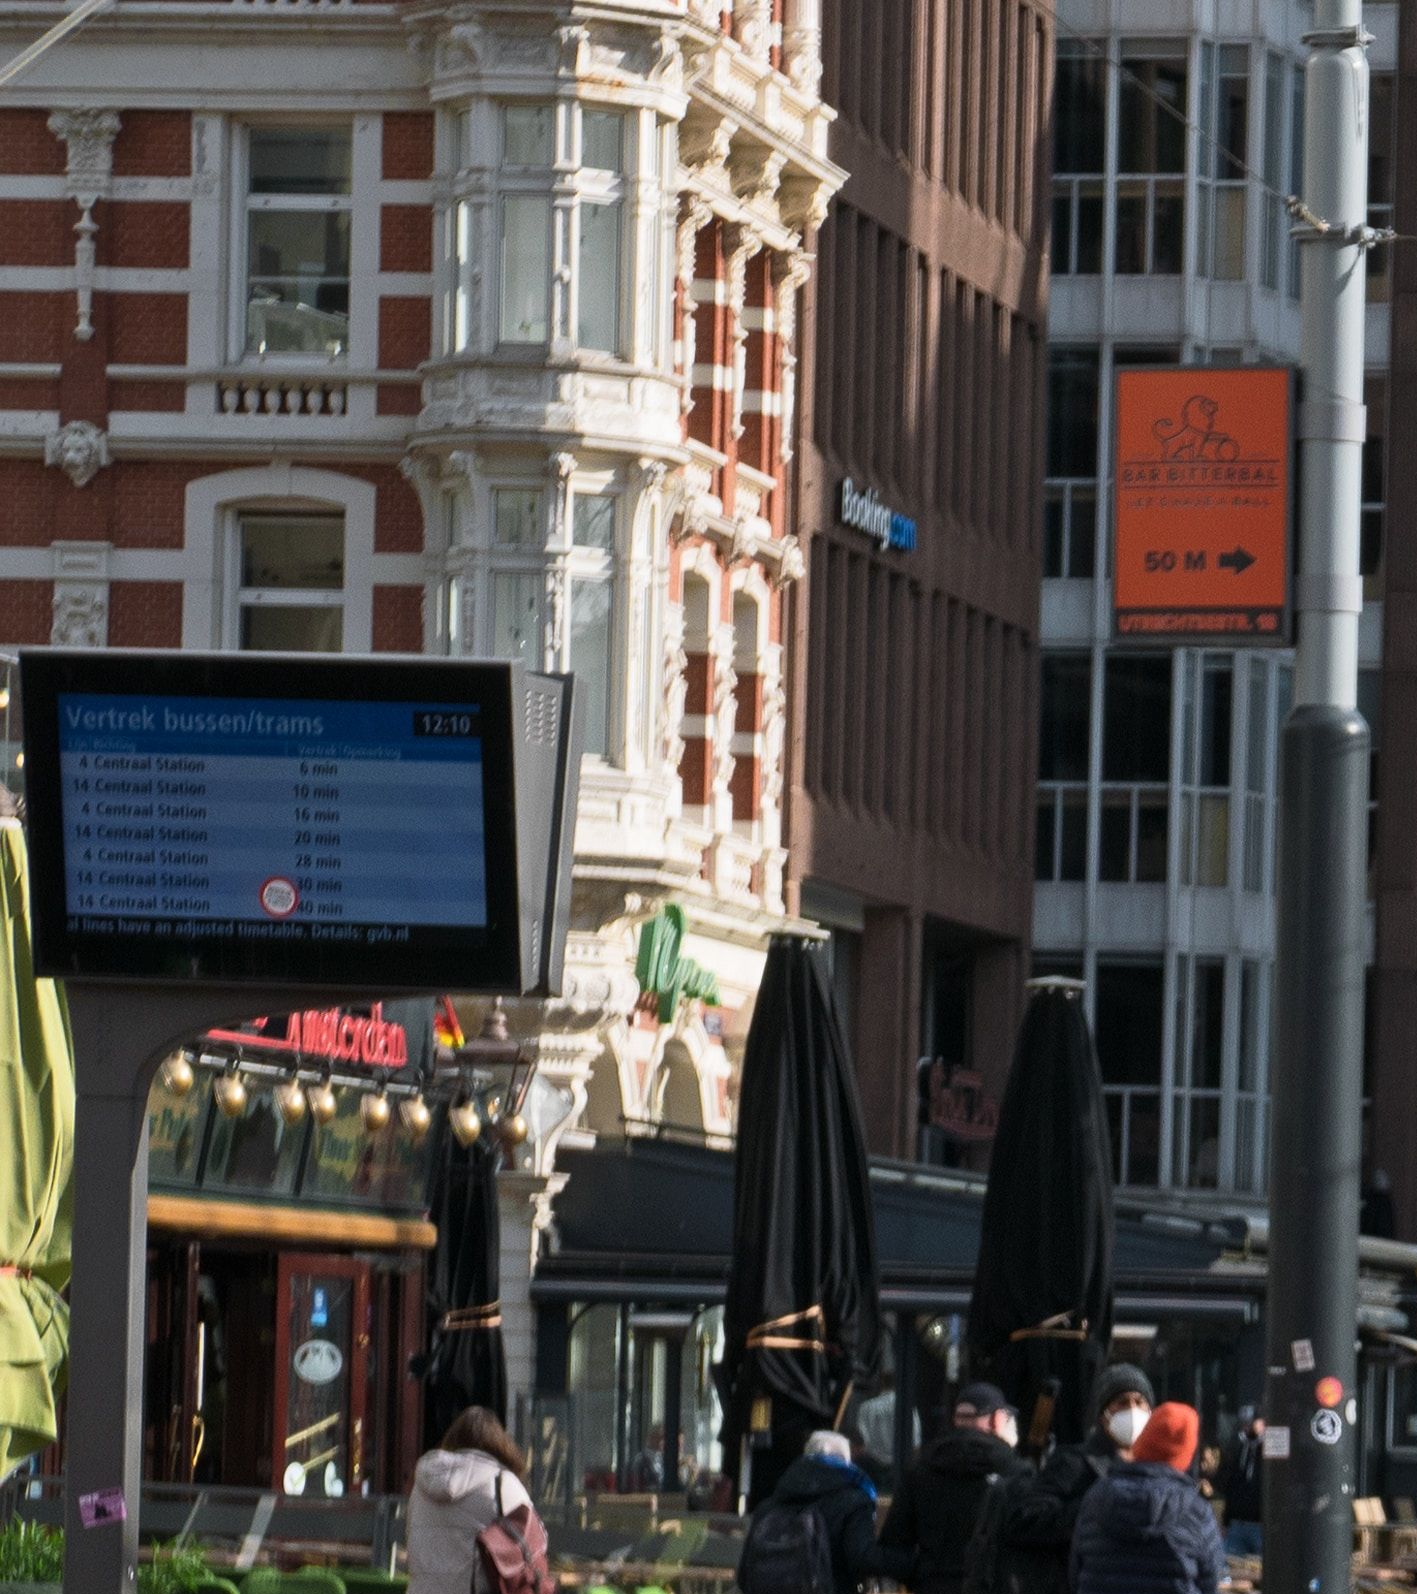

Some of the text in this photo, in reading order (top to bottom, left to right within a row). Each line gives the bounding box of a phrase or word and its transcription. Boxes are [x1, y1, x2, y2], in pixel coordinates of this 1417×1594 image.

[1144, 550, 1207, 573] 50 M
[66, 705, 325, 736] Vertrek bussen/trams
[422, 713, 471, 735] 12:10
[79, 755, 338, 776] 4 Centraal Station 6 min
[73, 778, 339, 800] 14 Centraal Station 10 min
[81, 802, 340, 823] 4 Centraal Station 16 min
[75, 825, 341, 847] 14 Centraal Station 20 min
[83, 848, 342, 870] 4 Centraal Station 28 min
[77, 871, 93, 885] 14
[99, 871, 156, 887] Centraal
[160, 872, 210, 889] Station
[317, 877, 342, 893] min
[79, 894, 93, 908] 14
[100, 894, 157, 910] Centraal
[161, 895, 210, 912] Station
[318, 901, 344, 916] min
[118, 918, 150, 933] have
[154, 921, 171, 934] an
[175, 919, 234, 938] adjusted
